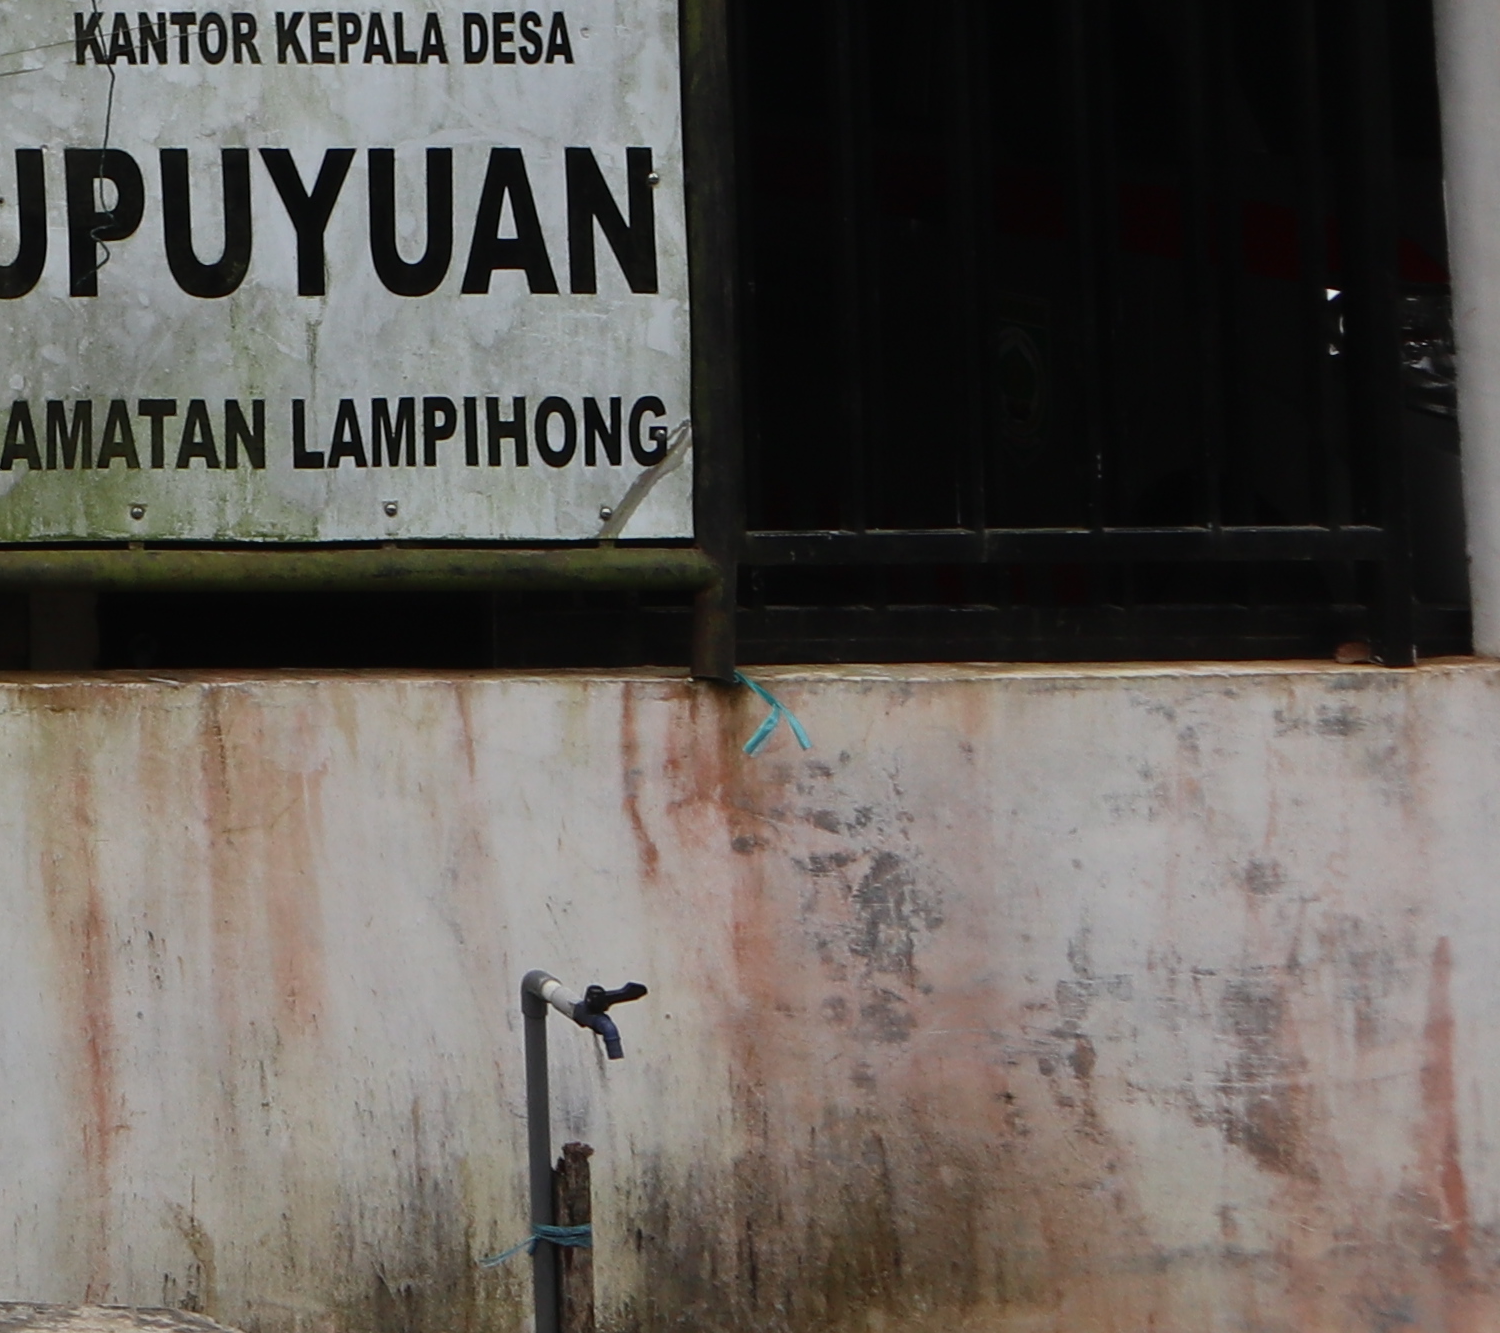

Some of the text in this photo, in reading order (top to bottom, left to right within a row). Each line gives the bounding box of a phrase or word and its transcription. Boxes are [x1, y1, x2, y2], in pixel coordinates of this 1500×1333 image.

[74, 10, 574, 65] KANTOR KEPALA DESA
[292, 395, 669, 469] LAMPIHONG
